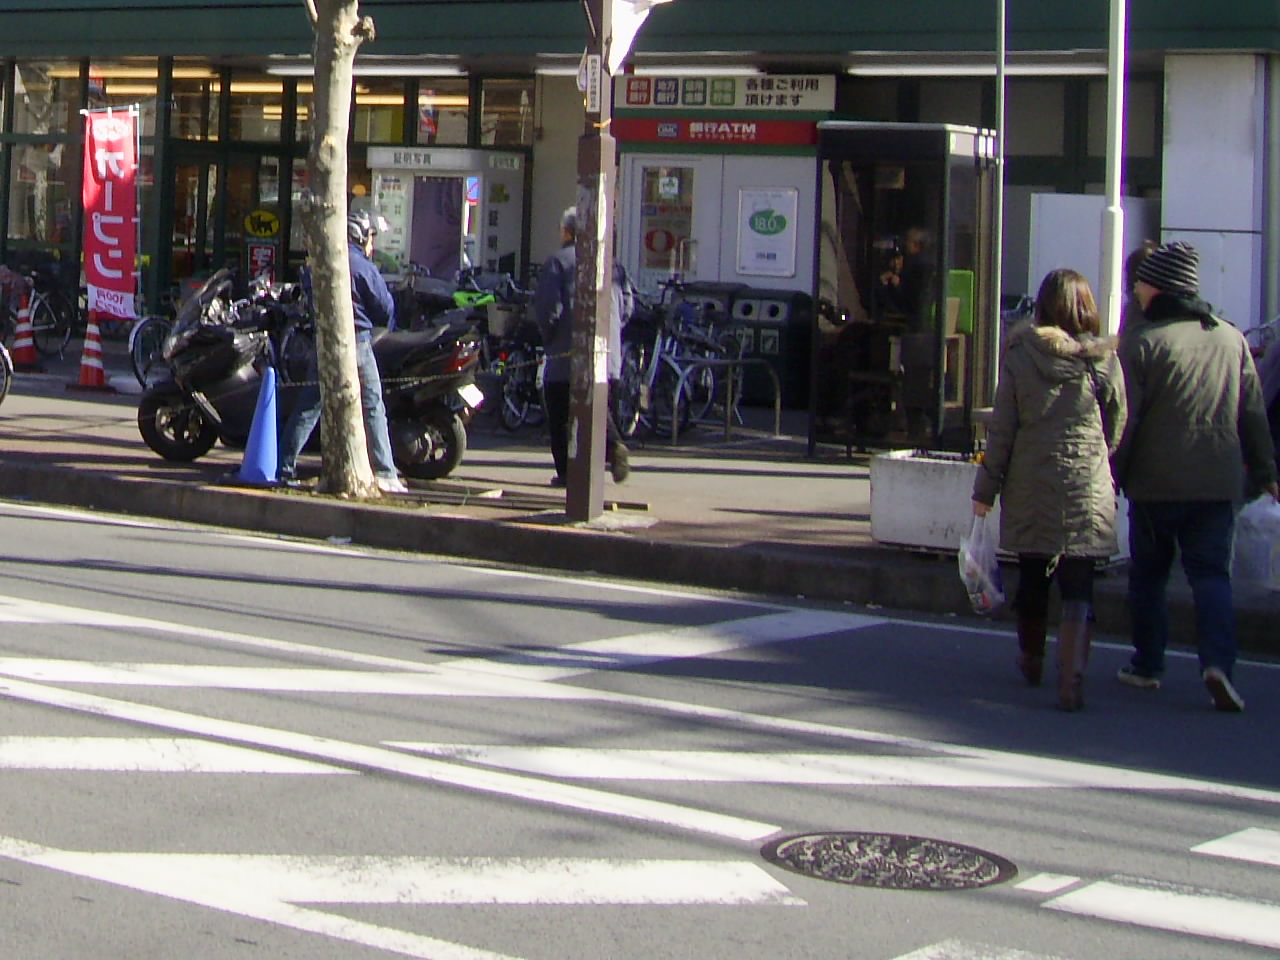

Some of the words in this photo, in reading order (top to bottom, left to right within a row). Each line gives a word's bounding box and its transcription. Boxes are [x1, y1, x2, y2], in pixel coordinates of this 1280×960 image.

[746, 79, 819, 90] 各種ご利用
[745, 93, 804, 106] 頂けます
[689, 122, 756, 134] 銀行ATM
[393, 151, 432, 165] 証明写真
